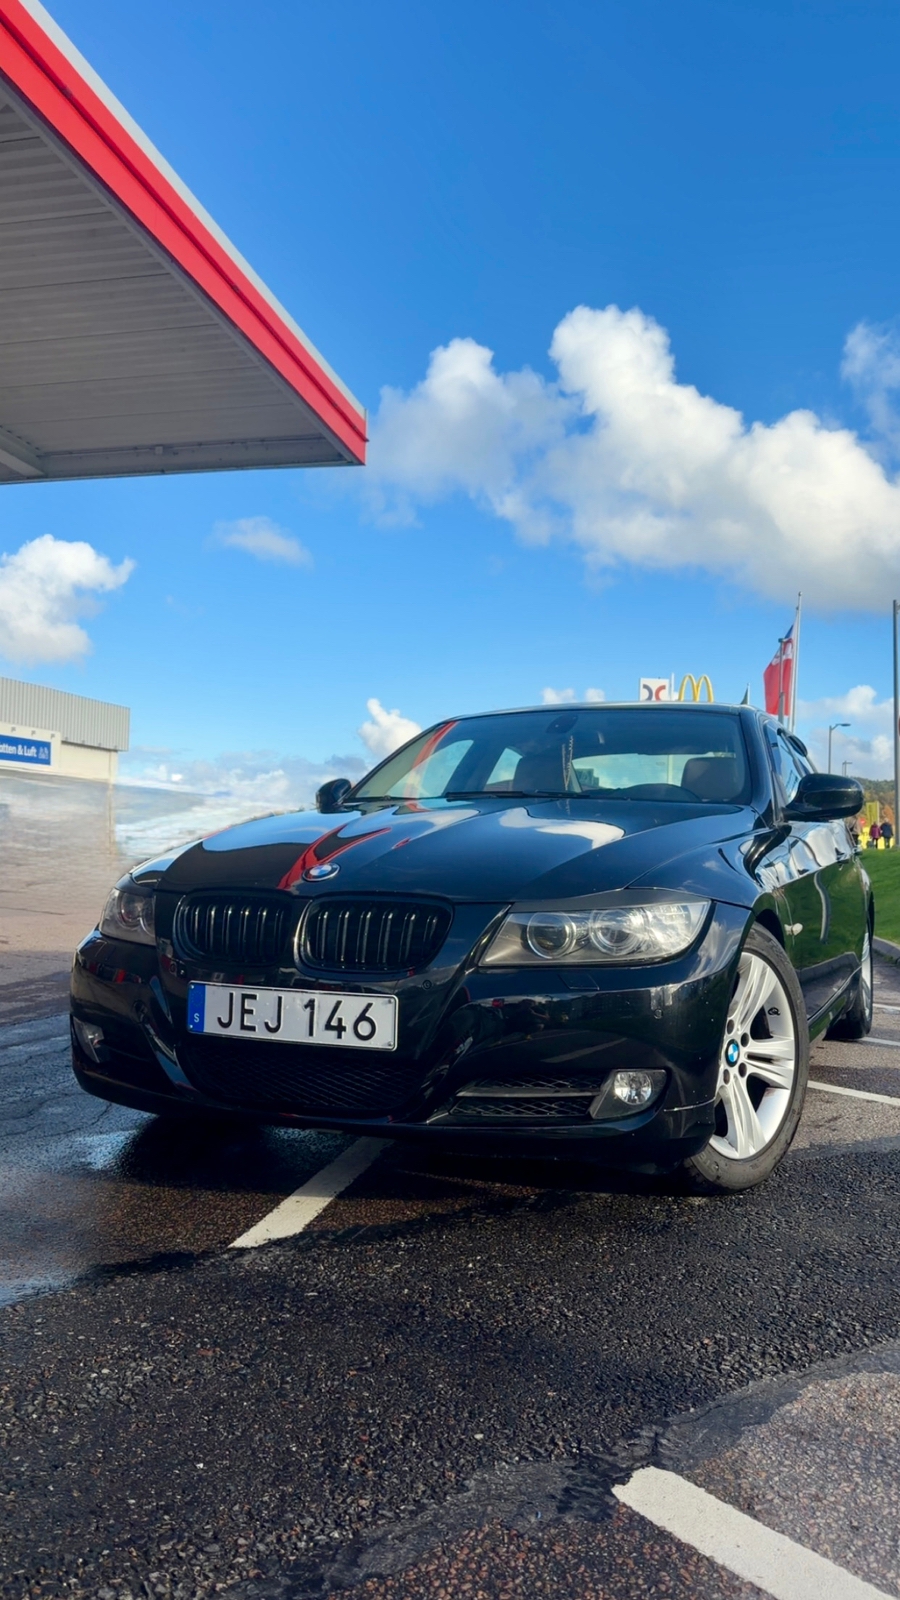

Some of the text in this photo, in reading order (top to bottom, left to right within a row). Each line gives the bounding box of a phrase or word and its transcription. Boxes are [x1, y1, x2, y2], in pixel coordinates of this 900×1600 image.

[18, 744, 23, 755] &
[24, 745, 37, 757] Luft
[193, 1012, 200, 1023] S
[217, 992, 377, 1041] JEJ 146
